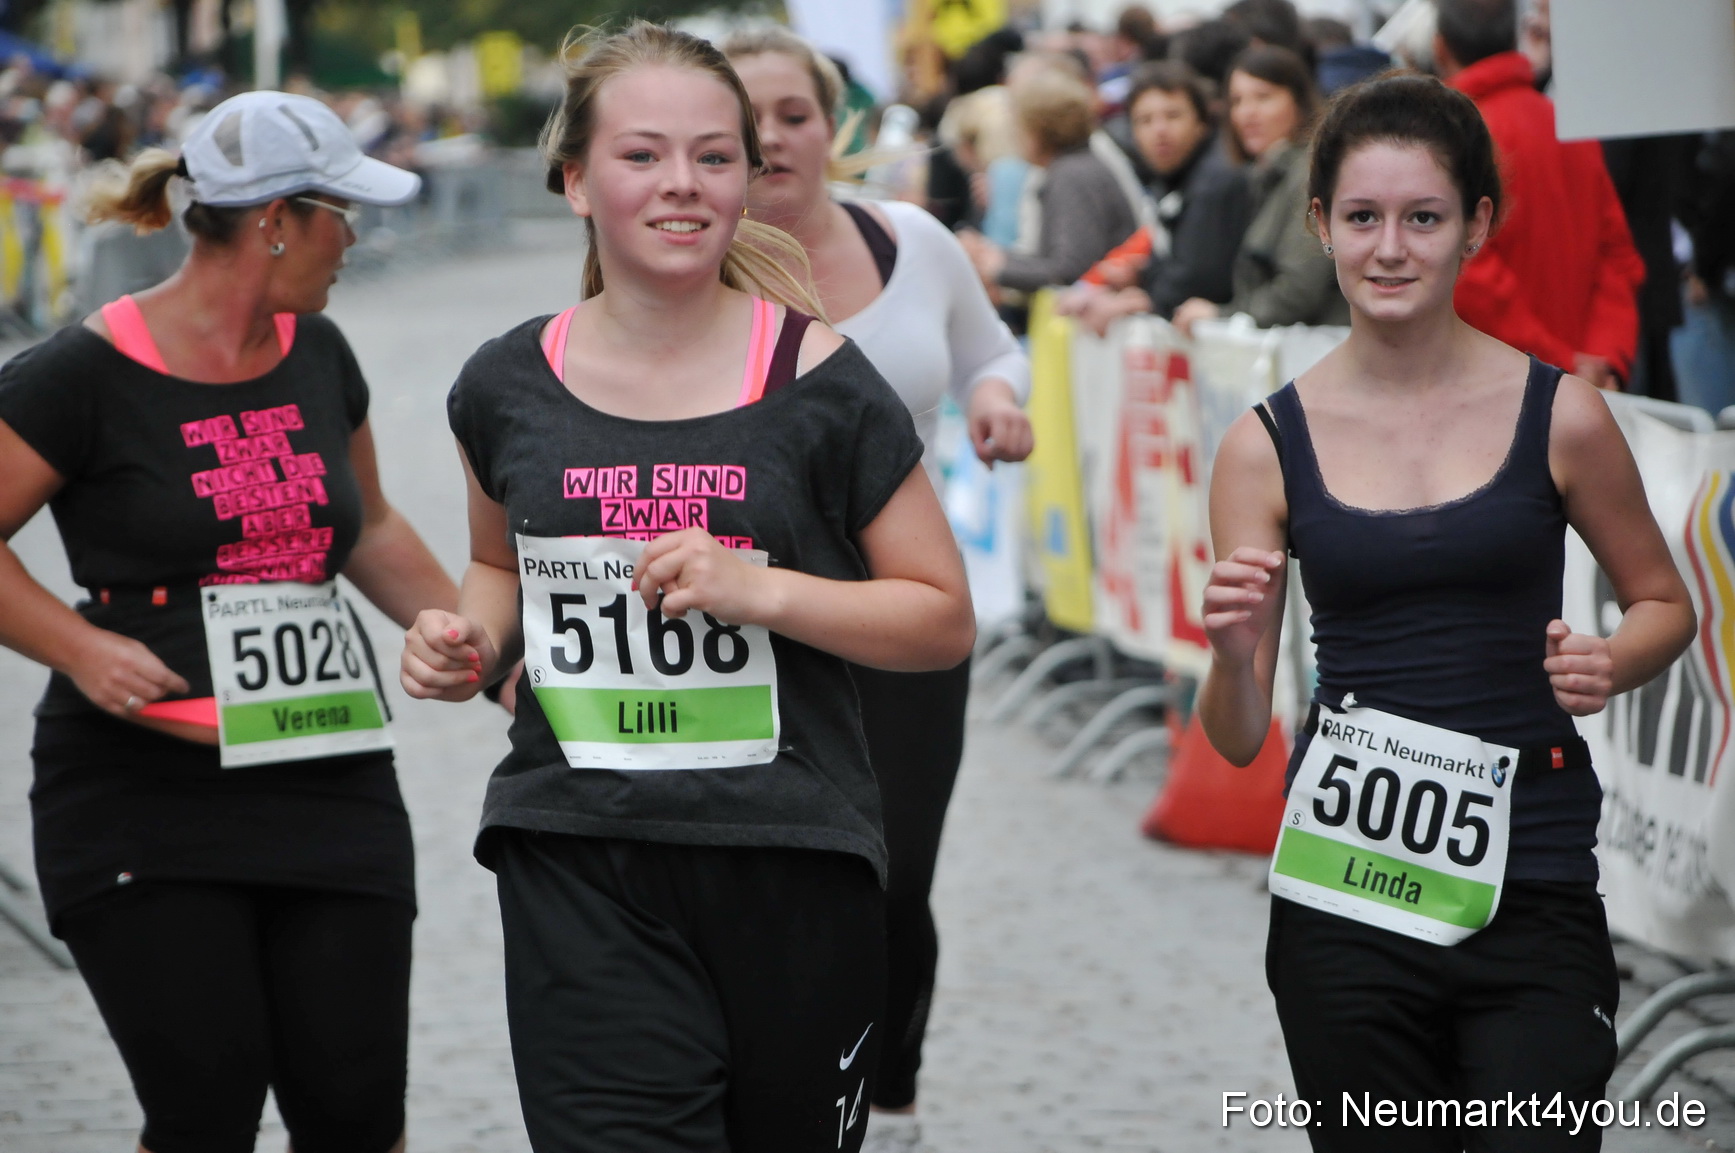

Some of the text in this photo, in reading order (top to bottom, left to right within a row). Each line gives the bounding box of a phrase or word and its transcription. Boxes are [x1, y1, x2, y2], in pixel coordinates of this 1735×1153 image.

[182, 406, 303, 445] WIR SIND
[216, 433, 291, 464] ZWAR
[193, 454, 326, 496] NICHT DIE
[565, 466, 744, 497] WIR SIND
[243, 504, 310, 537] ABER
[603, 501, 706, 530] ZWAR
[523, 557, 598, 581] PARTL
[208, 598, 273, 619] PARTL
[549, 592, 750, 677] 5168
[232, 618, 361, 691] 5028
[533, 668, 542, 684] S
[272, 704, 351, 733] Verena
[618, 701, 678, 734] Lilli
[1322, 718, 1485, 780] PARTL Neumarkt
[1291, 812, 1301, 826] S
[1312, 753, 1494, 867] 5005
[1342, 856, 1423, 905] Linda
